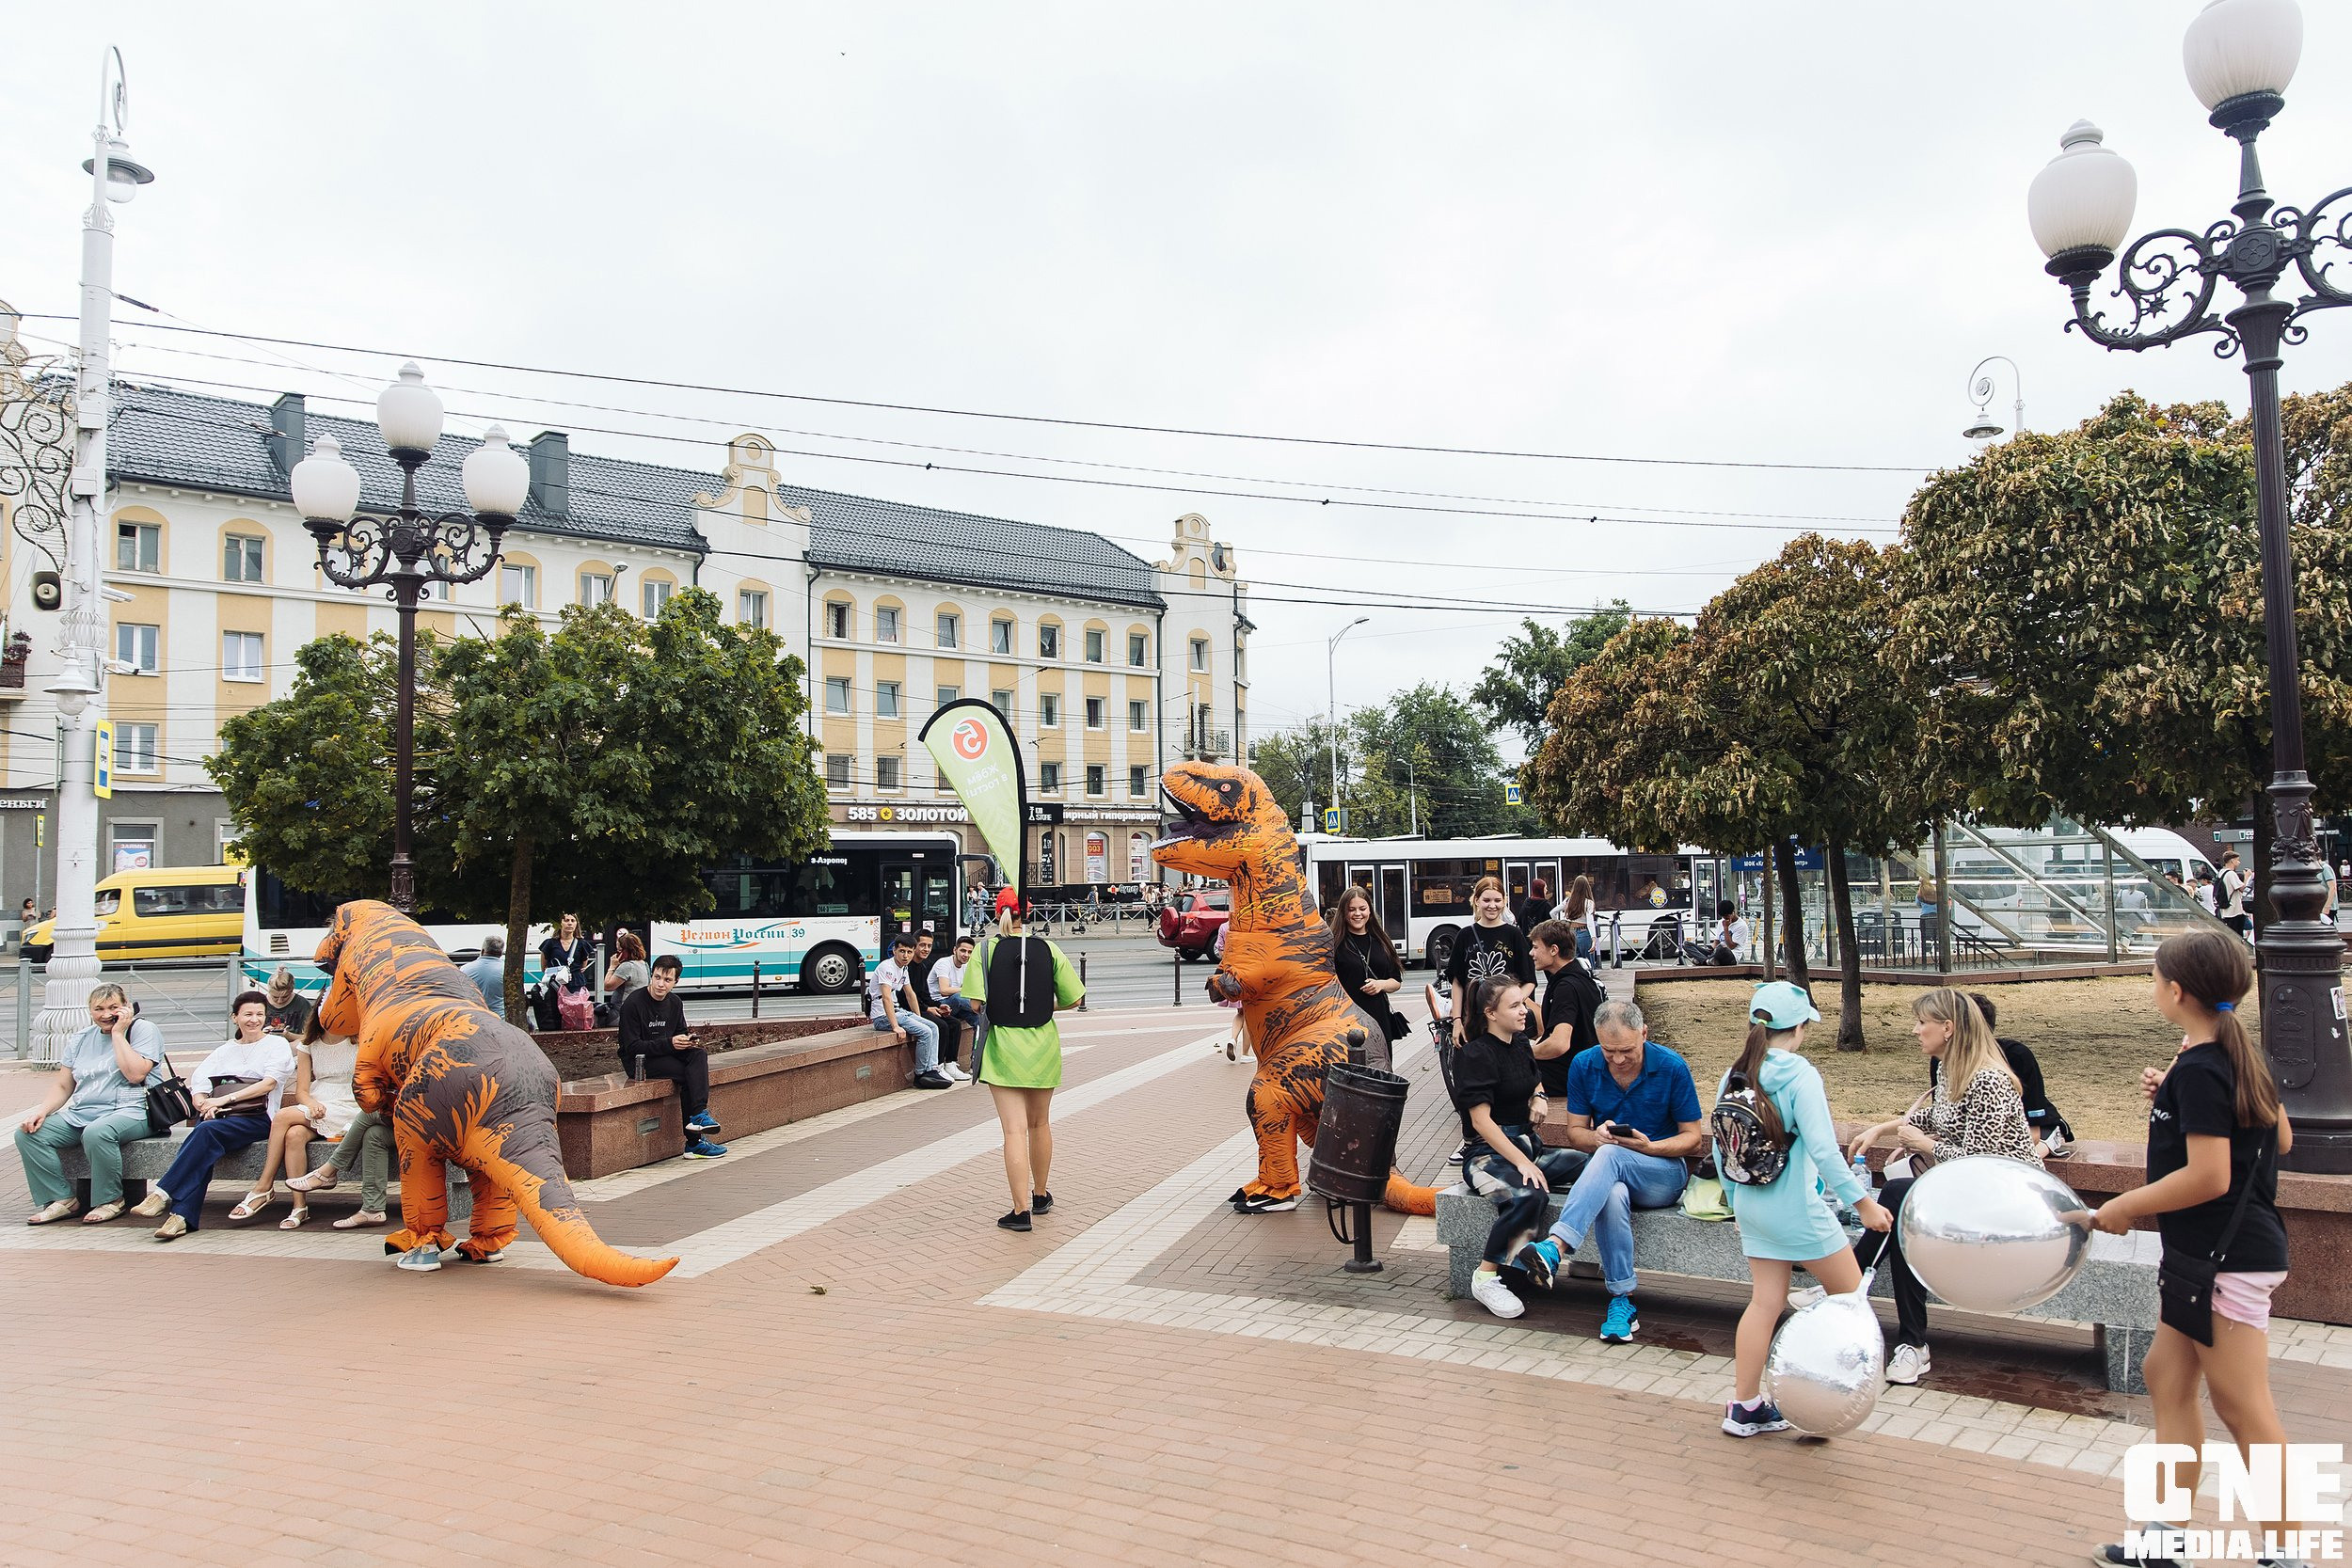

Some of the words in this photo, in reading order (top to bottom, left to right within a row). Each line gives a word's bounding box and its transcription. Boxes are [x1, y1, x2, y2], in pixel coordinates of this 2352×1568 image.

[848, 807, 878, 820] 585
[896, 806, 969, 821] ЗОЛОТОЙ
[1101, 811, 1162, 822] гипермаркет
[680, 929, 730, 942] Регион
[732, 928, 785, 942] России
[1494, 941, 1514, 958] Take
